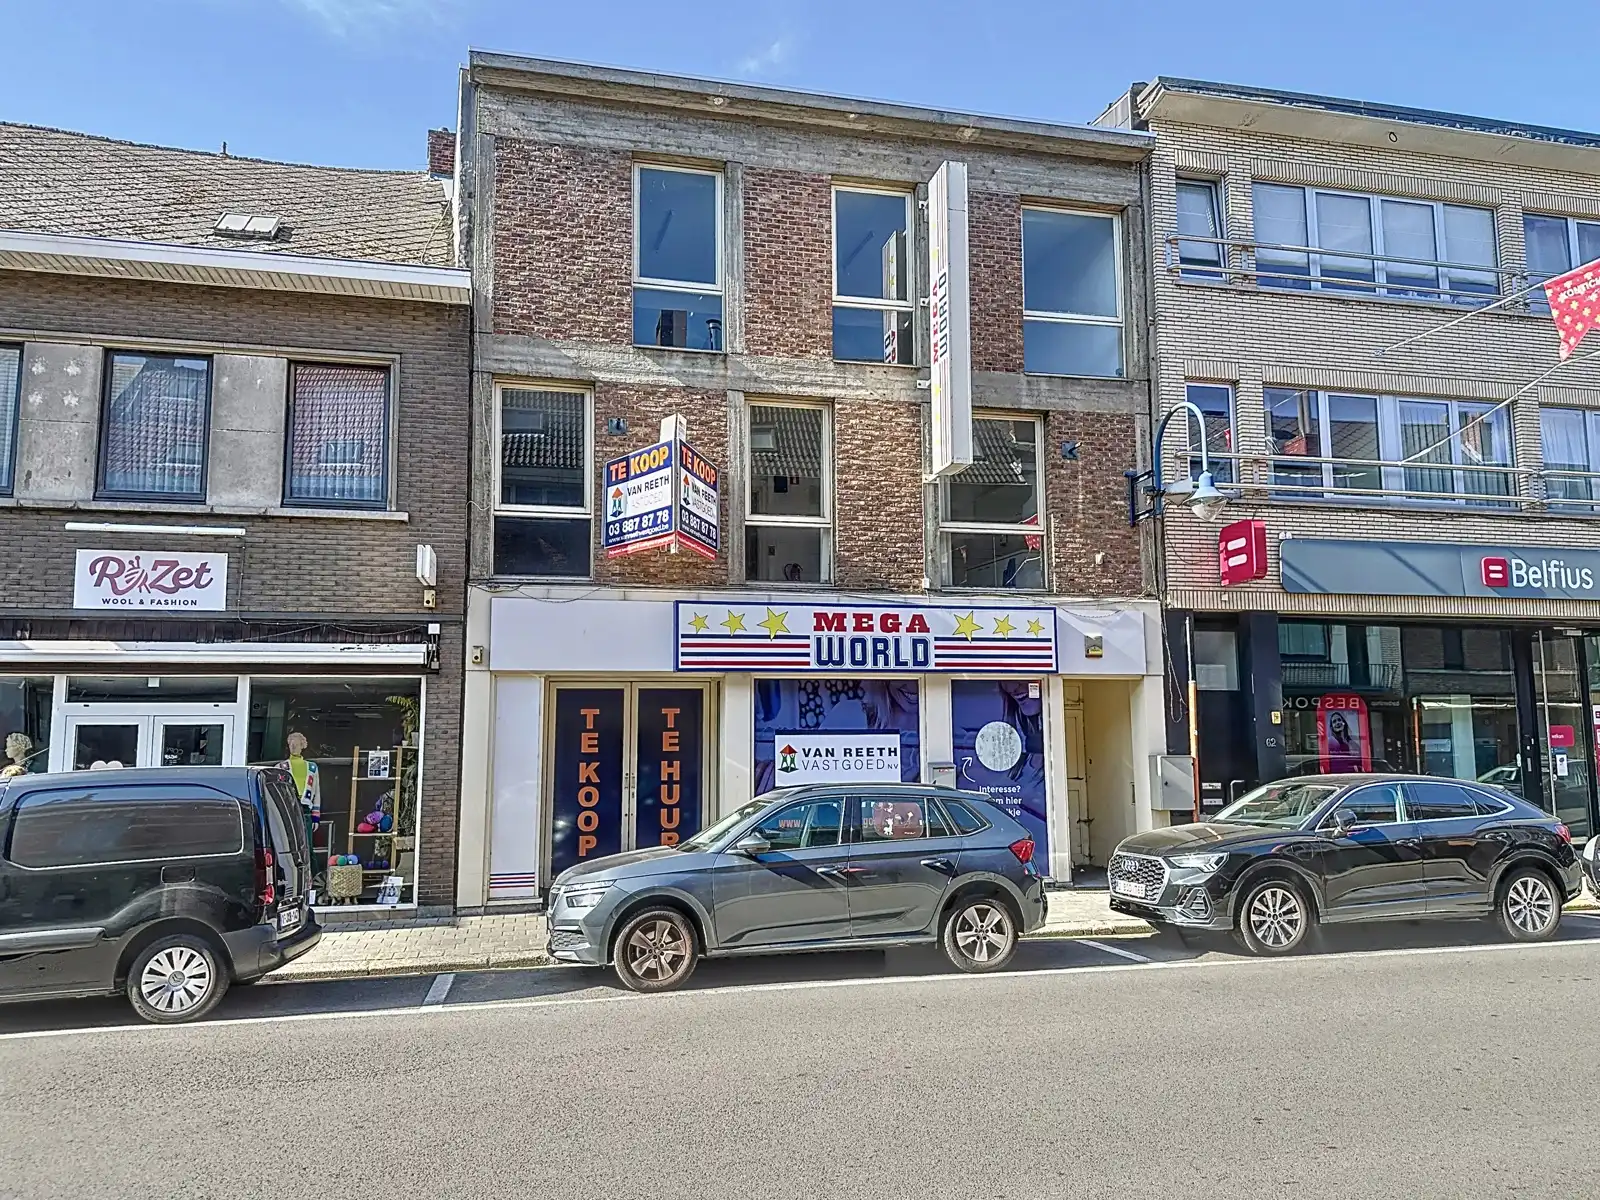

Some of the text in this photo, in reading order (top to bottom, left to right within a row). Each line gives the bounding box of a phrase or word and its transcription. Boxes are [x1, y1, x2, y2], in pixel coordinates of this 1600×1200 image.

[939, 272, 948, 357] WORLD
[609, 446, 669, 481] TE KOOP
[681, 445, 716, 485] TE KOOP
[627, 474, 670, 497] VAN REETH
[608, 509, 669, 537] 03 887 87 78
[681, 509, 717, 540] 03 887 87 78
[1511, 558, 1594, 590] Belfius
[101, 598, 197, 607] WOOL & FASHION
[813, 611, 931, 634] MEGA
[814, 635, 931, 668] WORLD
[580, 708, 600, 753] TE
[661, 708, 680, 752] TE
[1265, 737, 1277, 748] 62
[802, 747, 898, 757] VAN REETH
[802, 759, 885, 770] VASTGOED
[979, 785, 1021, 793] Interesse?
[1005, 796, 1022, 804] hier
[577, 762, 601, 857] KOOP
